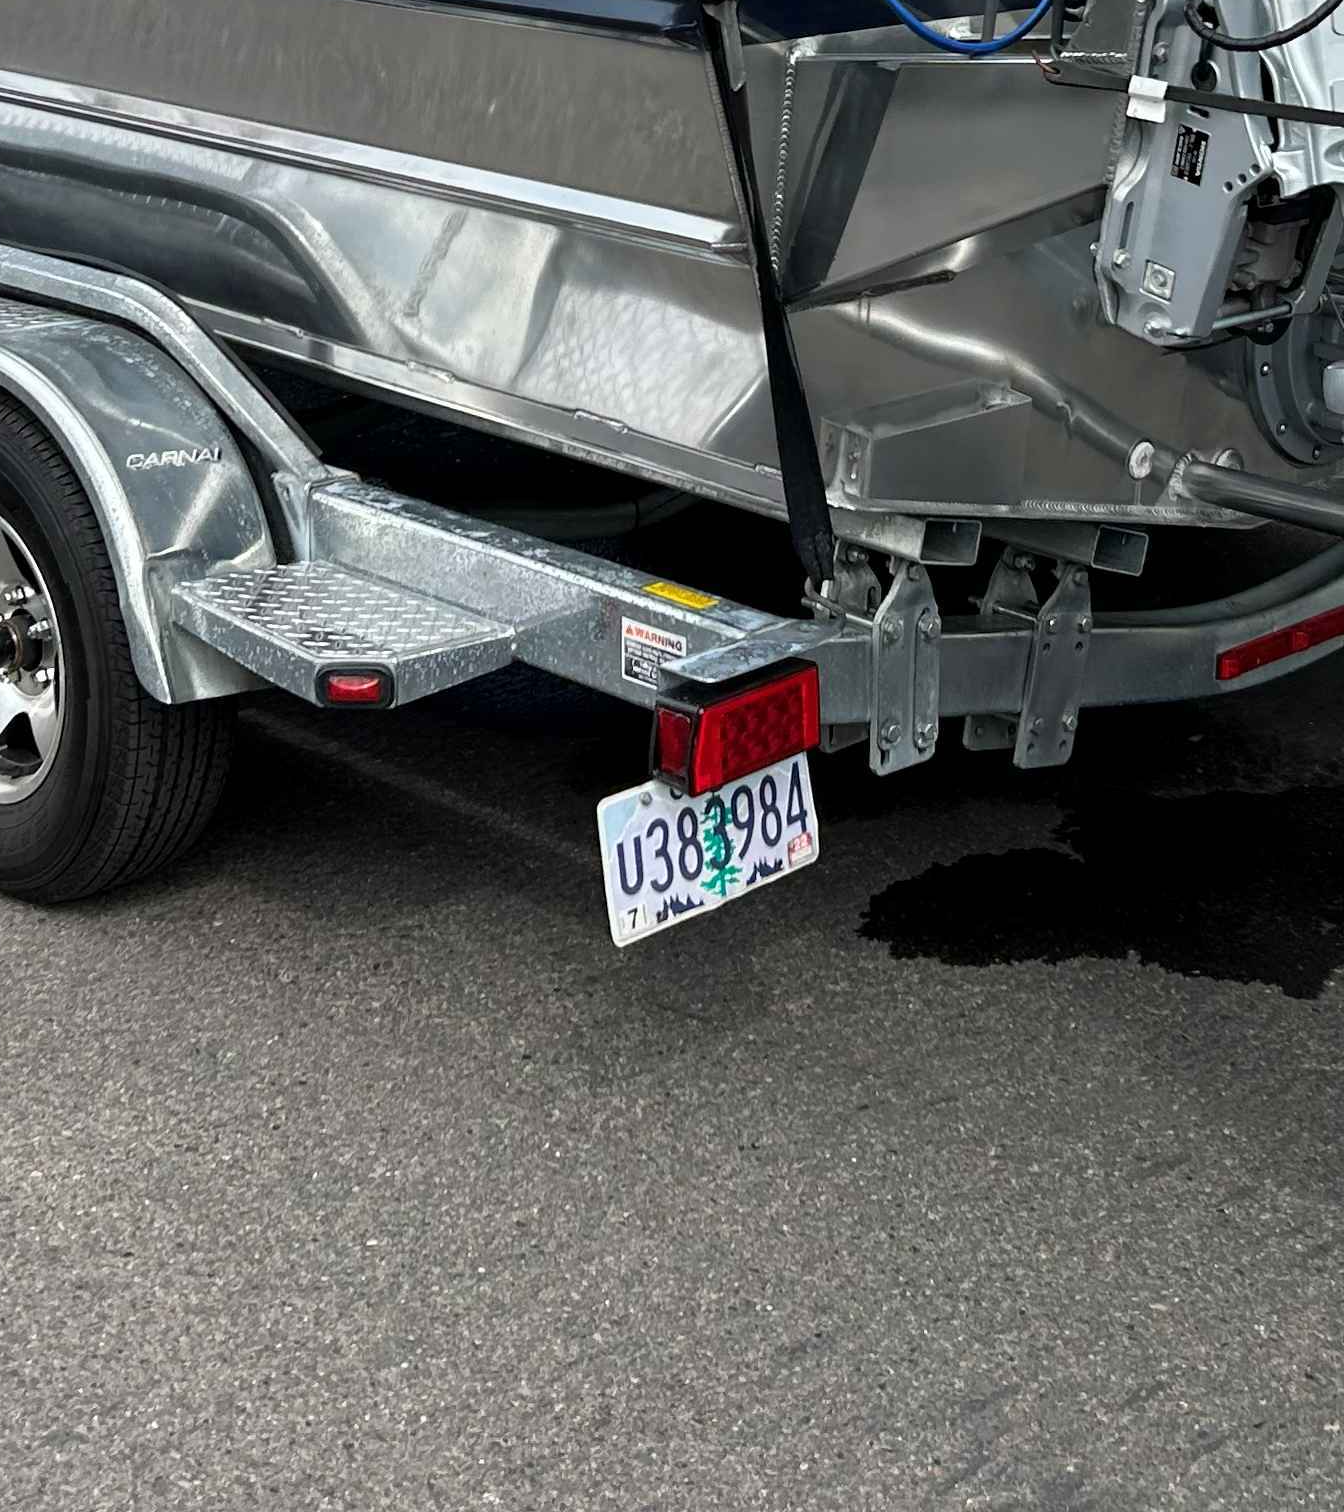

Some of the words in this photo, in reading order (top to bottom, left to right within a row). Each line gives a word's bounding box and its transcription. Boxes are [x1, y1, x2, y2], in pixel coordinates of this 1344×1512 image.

[634, 624, 683, 652] WARNING
[617, 761, 809, 896] U383984
[627, 908, 639, 929] 7
